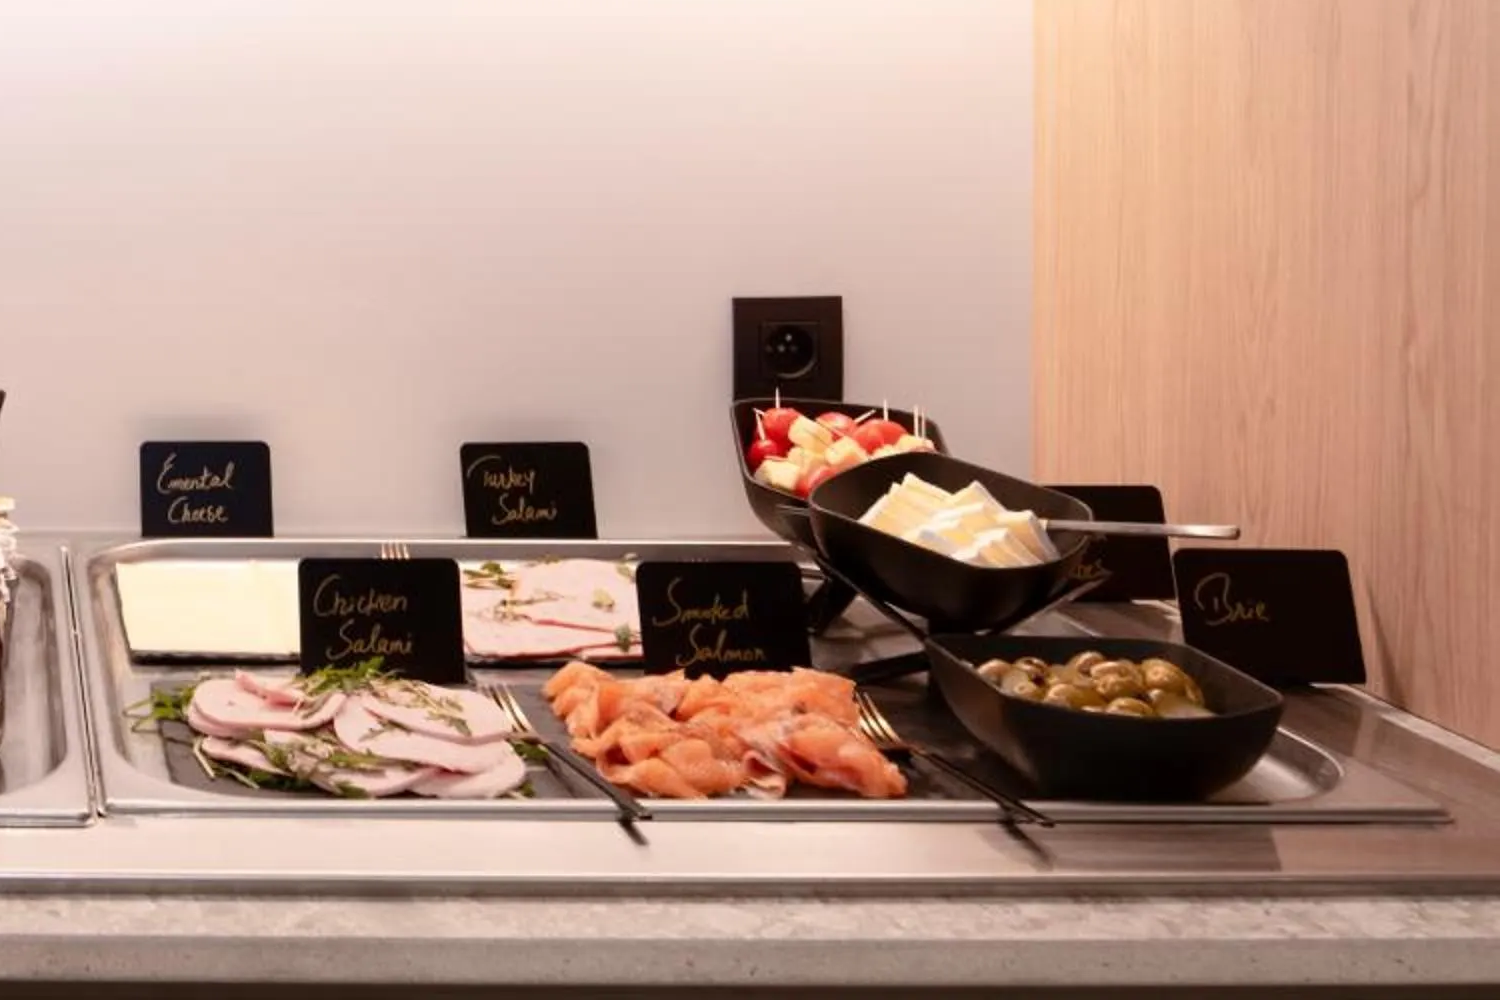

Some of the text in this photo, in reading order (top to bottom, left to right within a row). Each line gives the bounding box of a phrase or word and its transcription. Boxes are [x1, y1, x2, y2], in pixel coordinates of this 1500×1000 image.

[466, 454, 535, 495] Turkey
[167, 496, 229, 524] Cheese
[491, 493, 558, 526] Salami
[313, 574, 407, 617] Chicken
[652, 576, 749, 626] Smoked
[1194, 572, 1269, 626] Brie
[325, 618, 413, 661] Salami
[675, 623, 766, 667] Salmon
